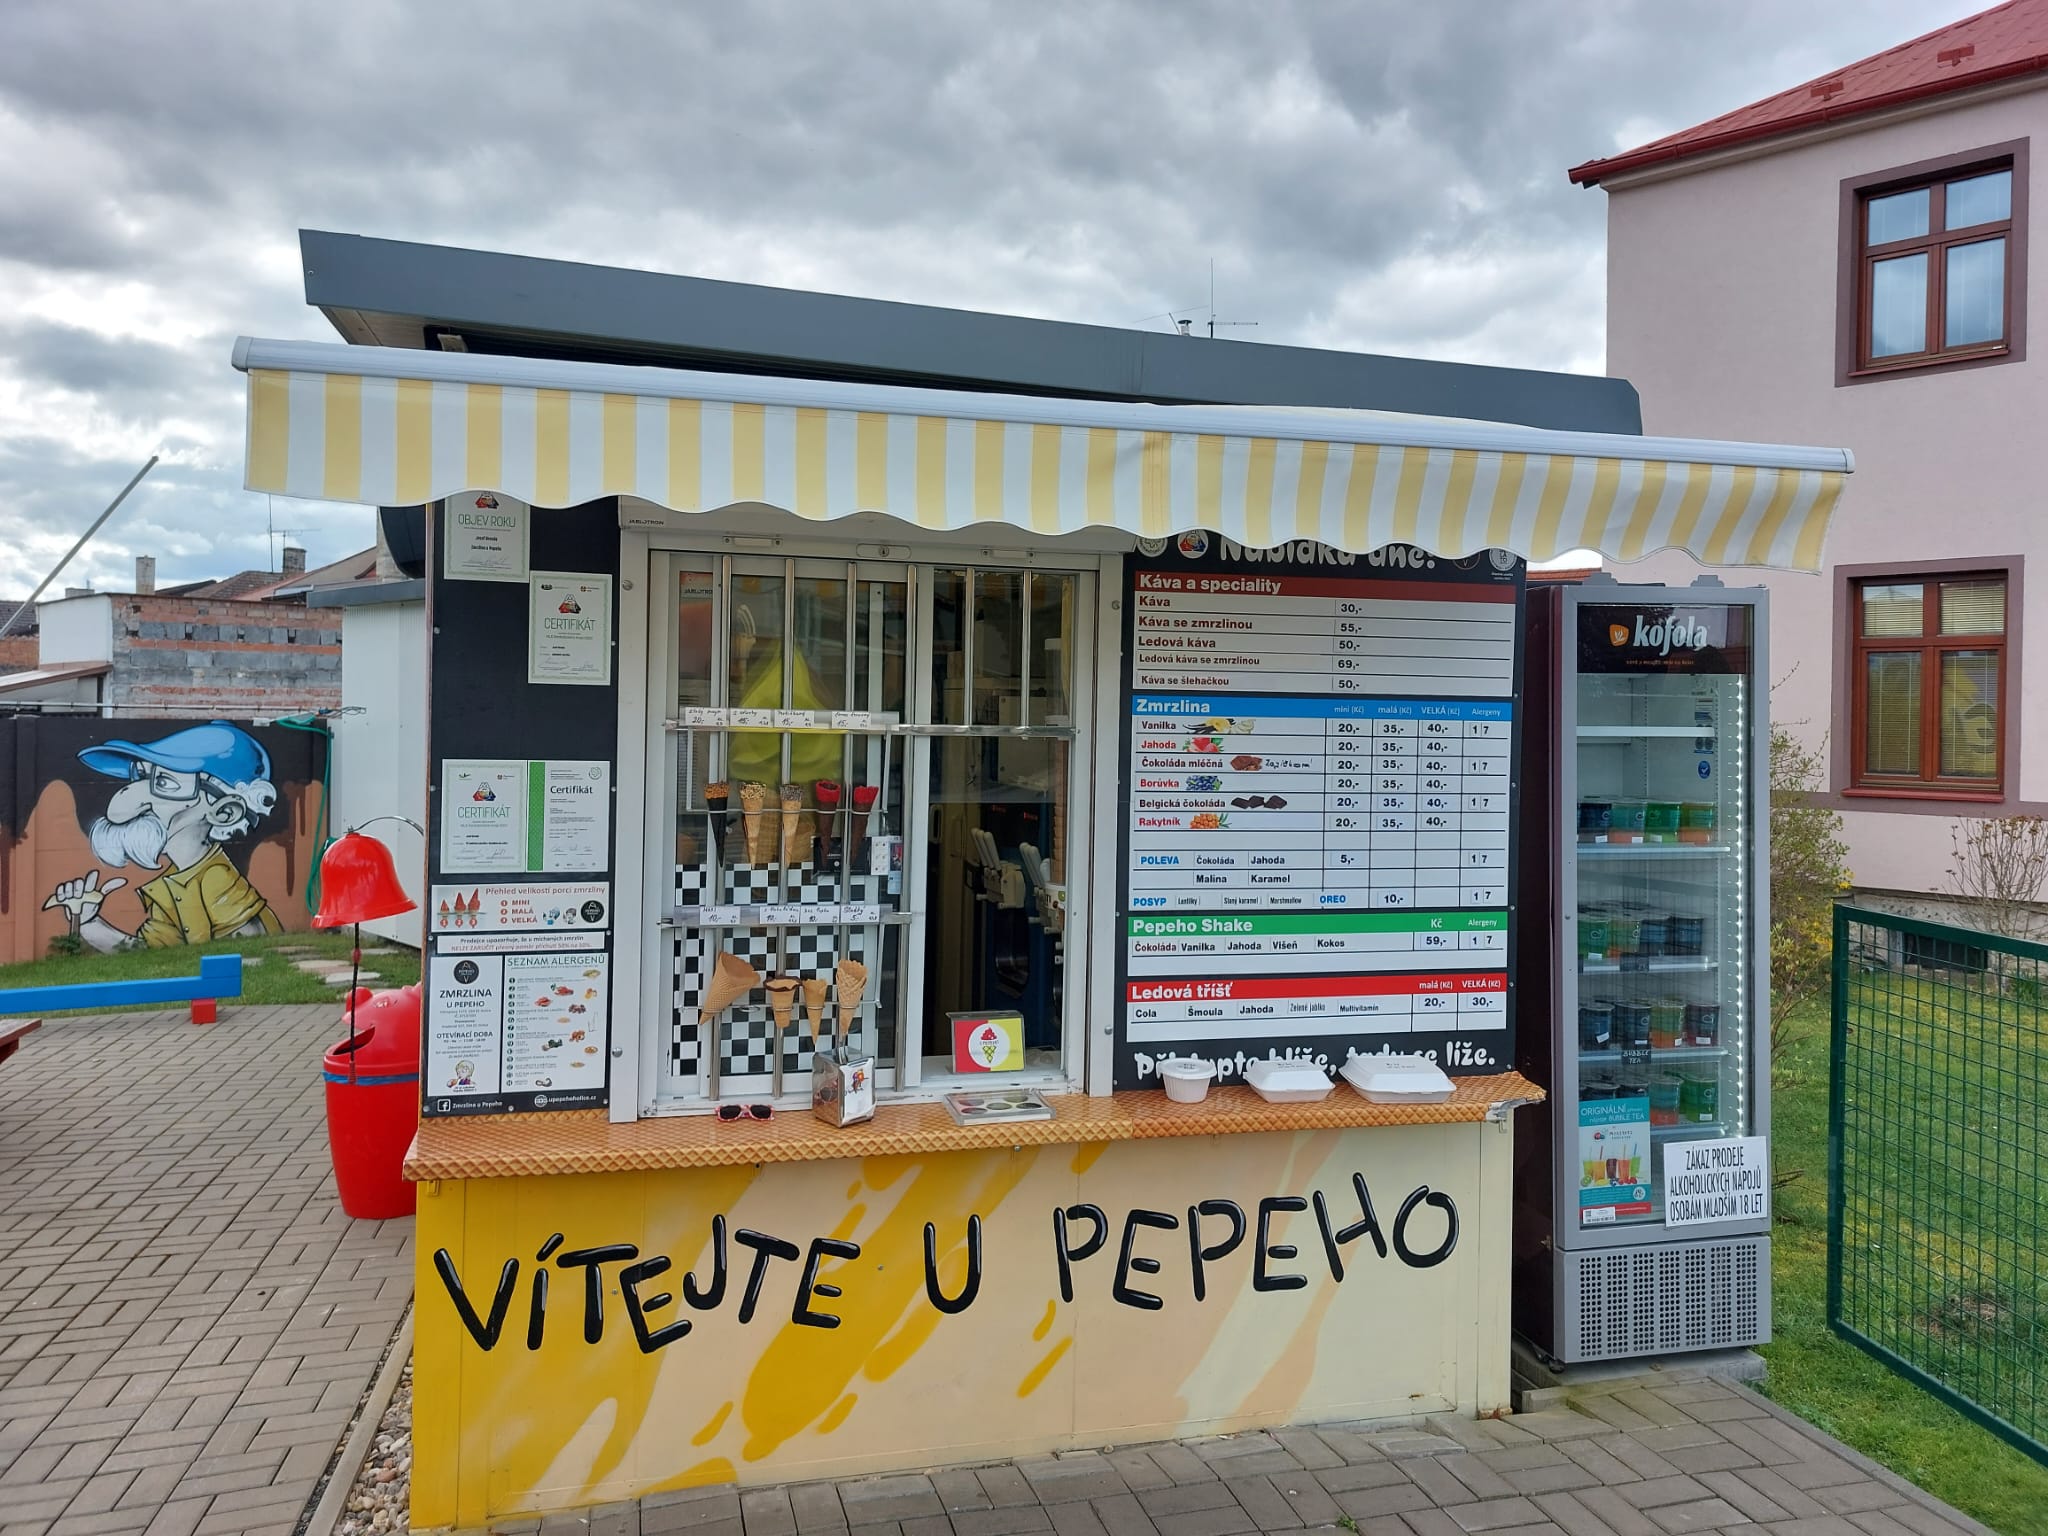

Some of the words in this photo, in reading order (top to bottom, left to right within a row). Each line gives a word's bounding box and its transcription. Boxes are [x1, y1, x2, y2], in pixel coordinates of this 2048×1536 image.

[458, 514, 489, 526] OBJEV
[491, 515, 516, 528] ROKU
[1140, 574, 1182, 589] Káva
[1186, 578, 1196, 589] a
[1200, 577, 1281, 595] speciality
[1139, 595, 1171, 608] Káva
[1341, 603, 1362, 615] 30,-
[544, 616, 597, 631] CERTIFIKÁT
[1139, 616, 1170, 629] Káva
[1173, 619, 1188, 629] se
[1191, 619, 1253, 630] zmrzlinou
[1340, 623, 1362, 635] 55,-
[1633, 615, 1708, 656] kofola
[1138, 636, 1182, 649] Ledová
[1185, 637, 1216, 649] káva
[1338, 640, 1361, 652] 50,-
[1139, 653, 1174, 665] Ledová
[1176, 654, 1199, 665] káva
[1200, 657, 1212, 665] se
[1213, 656, 1260, 666] zmrzlinou
[1338, 659, 1360, 671] 69,-
[1141, 675, 1166, 686] Káva
[1167, 678, 1179, 686] se
[1181, 675, 1230, 687] šlehačkou
[1338, 679, 1361, 691] 50,-
[1136, 699, 1210, 713] Zmrzlina
[1334, 705, 1350, 713] mini
[1378, 706, 1398, 714] malá
[1421, 705, 1446, 715] VELKÁ
[1471, 708, 1501, 717] Alergeny
[1142, 721, 1177, 730] Vanilka
[1338, 723, 1360, 734] 20,-
[1383, 724, 1404, 734] 35,-
[1427, 723, 1448, 733] 40,-
[1472, 726, 1478, 734] 1
[1483, 726, 1489, 735] 7
[1141, 740, 1177, 750] Jahoda
[1338, 742, 1360, 752] 20,-
[1382, 743, 1403, 753] 35,-
[1426, 742, 1448, 752] 40,-
[1142, 756, 1186, 768] Čokoláda
[1188, 757, 1223, 768] mléčná
[1338, 760, 1360, 771] 20,-
[1382, 760, 1403, 770] 35,-
[1426, 761, 1447, 772] 40,-
[1471, 762, 1477, 771] 1
[1482, 762, 1488, 771] 7
[1140, 778, 1180, 788] Borůvka
[1338, 779, 1359, 789] 20,-
[1382, 779, 1403, 790] 35,-
[1426, 779, 1447, 789] 40,-
[550, 784, 594, 795] Certifikát
[1139, 798, 1181, 810] Belgická
[1183, 798, 1226, 809] čokoláda
[1337, 797, 1358, 808] 20,-
[1383, 798, 1404, 809] 35,-
[1427, 798, 1448, 808] 40,-
[1471, 798, 1476, 807] 1
[1483, 799, 1489, 807] 7
[457, 803, 512, 819] CERTIFIKÁT
[1139, 816, 1181, 828] Rakytník
[1335, 818, 1357, 828] 20,-
[1382, 819, 1403, 829] 35,-
[1426, 816, 1447, 826] 40,-
[1140, 856, 1179, 865] POLEVA
[1196, 855, 1235, 865] Čokoláda
[1251, 856, 1285, 865] Jahoda
[1340, 854, 1354, 865] 5,-
[1471, 855, 1476, 863] 1
[1481, 855, 1487, 864] 7
[1196, 874, 1227, 883] Malina
[1251, 874, 1290, 883] Karamel
[485, 887, 517, 895] Přehled
[1485, 891, 1491, 900] 7
[1133, 897, 1167, 907] POSYP
[1238, 896, 1259, 905] karamel
[1319, 895, 1347, 904] OREO
[1384, 894, 1404, 904] 10,-
[1473, 892, 1479, 901] 1
[511, 915, 538, 924] VELKÁ
[1431, 918, 1443, 928] Kč
[1468, 918, 1498, 928] Alergeny
[1133, 919, 1197, 935] Pepeho
[1201, 918, 1253, 931] Shake
[1426, 936, 1447, 947] 59,-
[1472, 936, 1478, 945] 1
[1486, 935, 1492, 944] 7
[1135, 941, 1177, 952] Čokoláda
[1181, 942, 1216, 952] Vanilka
[1227, 941, 1262, 951] Jahoda
[1272, 940, 1298, 950] Višeň
[1316, 939, 1345, 948] Kokos
[507, 956, 549, 967] SEZNAM
[550, 954, 606, 965] ALERGENŮ
[1419, 981, 1439, 989] malá
[1462, 979, 1487, 988] VELKÁ
[439, 988, 492, 999] ZMRZLINA
[1132, 985, 1193, 1000] Ledová
[1196, 982, 1233, 998] tříšť
[446, 1001, 454, 1009] U
[454, 1000, 485, 1009] PEPEHO
[1424, 998, 1445, 1008] 20,-
[1472, 997, 1493, 1007] 30,-
[1135, 1009, 1157, 1018] Cola
[1188, 1005, 1223, 1016] Šmoula
[1239, 1005, 1274, 1015] Jahoda
[436, 1030, 472, 1039] OTEVÍRACÍ
[473, 1030, 493, 1038] DOBA
[1446, 1041, 1496, 1067] líže.
[452, 1102, 477, 1110] Zmrzlina
[1581, 1104, 1627, 1117] ORIGINÁLNÍ
[1608, 1112, 1631, 1122] BUBBLE
[1632, 1111, 1645, 1121] TEA
[1686, 1149, 1711, 1171] ZÁKAZ
[1712, 1146, 1744, 1168] PRODEJE
[1670, 1171, 1730, 1197] ALKOHOLICKÝCH
[1732, 1165, 1762, 1192] NÁPOJŮ
[1670, 1197, 1702, 1222] OSOBÁM
[1703, 1192, 1738, 1219] MLADŠÍM
[1739, 1194, 1749, 1214] 18
[1751, 1193, 1764, 1215] LET
[433, 1213, 861, 1354] VÍTEJTE
[924, 1214, 981, 1314] U
[1053, 1171, 1460, 1310] PEPEHO
